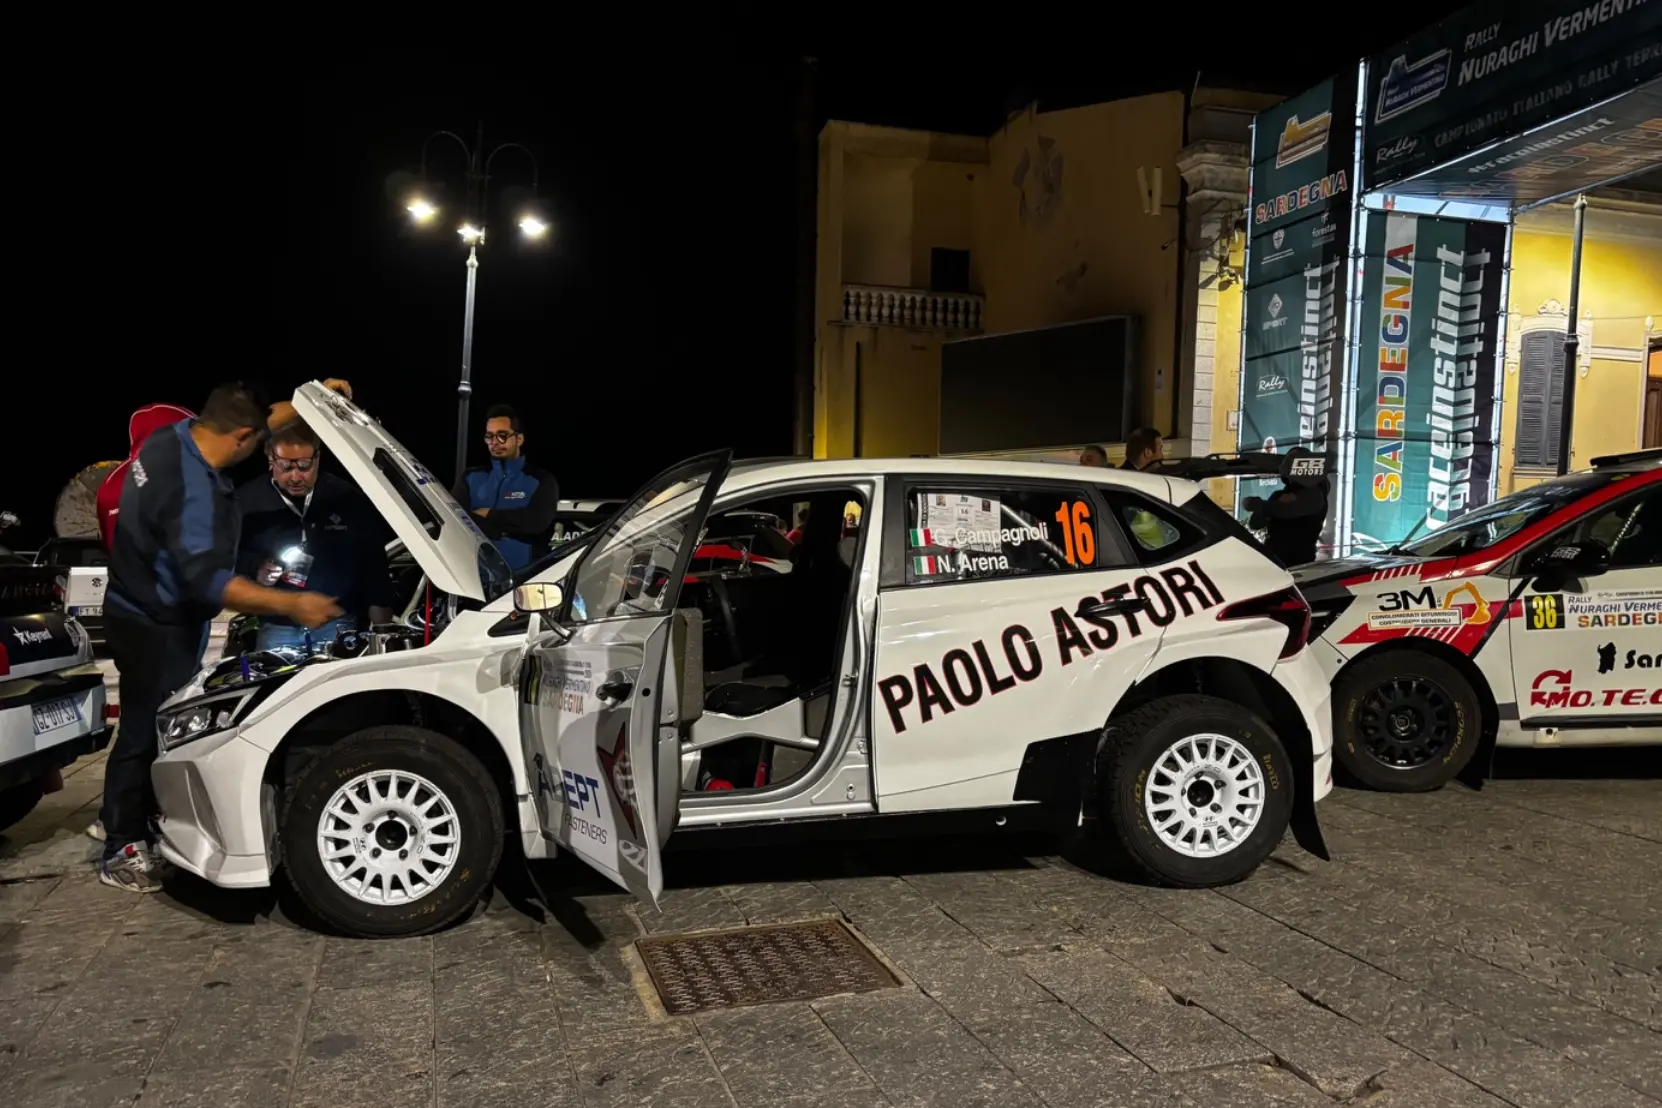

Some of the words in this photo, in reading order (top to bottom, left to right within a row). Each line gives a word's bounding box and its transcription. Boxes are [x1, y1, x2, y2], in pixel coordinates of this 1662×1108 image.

[1464, 21, 1502, 53] RALLY
[1458, 31, 1539, 87] NURAGHI
[1255, 168, 1349, 225] SARDEGNA
[1258, 374, 1286, 392] Rally
[1372, 242, 1416, 503] SARDEGNA
[1289, 467, 1325, 476] MOTORS
[954, 521, 1049, 549] Campagnoli
[1054, 499, 1096, 566] 16
[936, 556, 955, 574] N.
[959, 552, 1010, 573] Arena
[1376, 585, 1437, 612] 3M
[1531, 594, 1558, 629] 36
[1568, 595, 1592, 604] RALLY
[1568, 602, 1621, 615] NURAGHI
[1577, 611, 1662, 628] SARDEG
[877, 623, 1043, 734] PAOLO
[1049, 559, 1225, 667] ASTORI
[564, 813, 608, 845] FASTENERS
